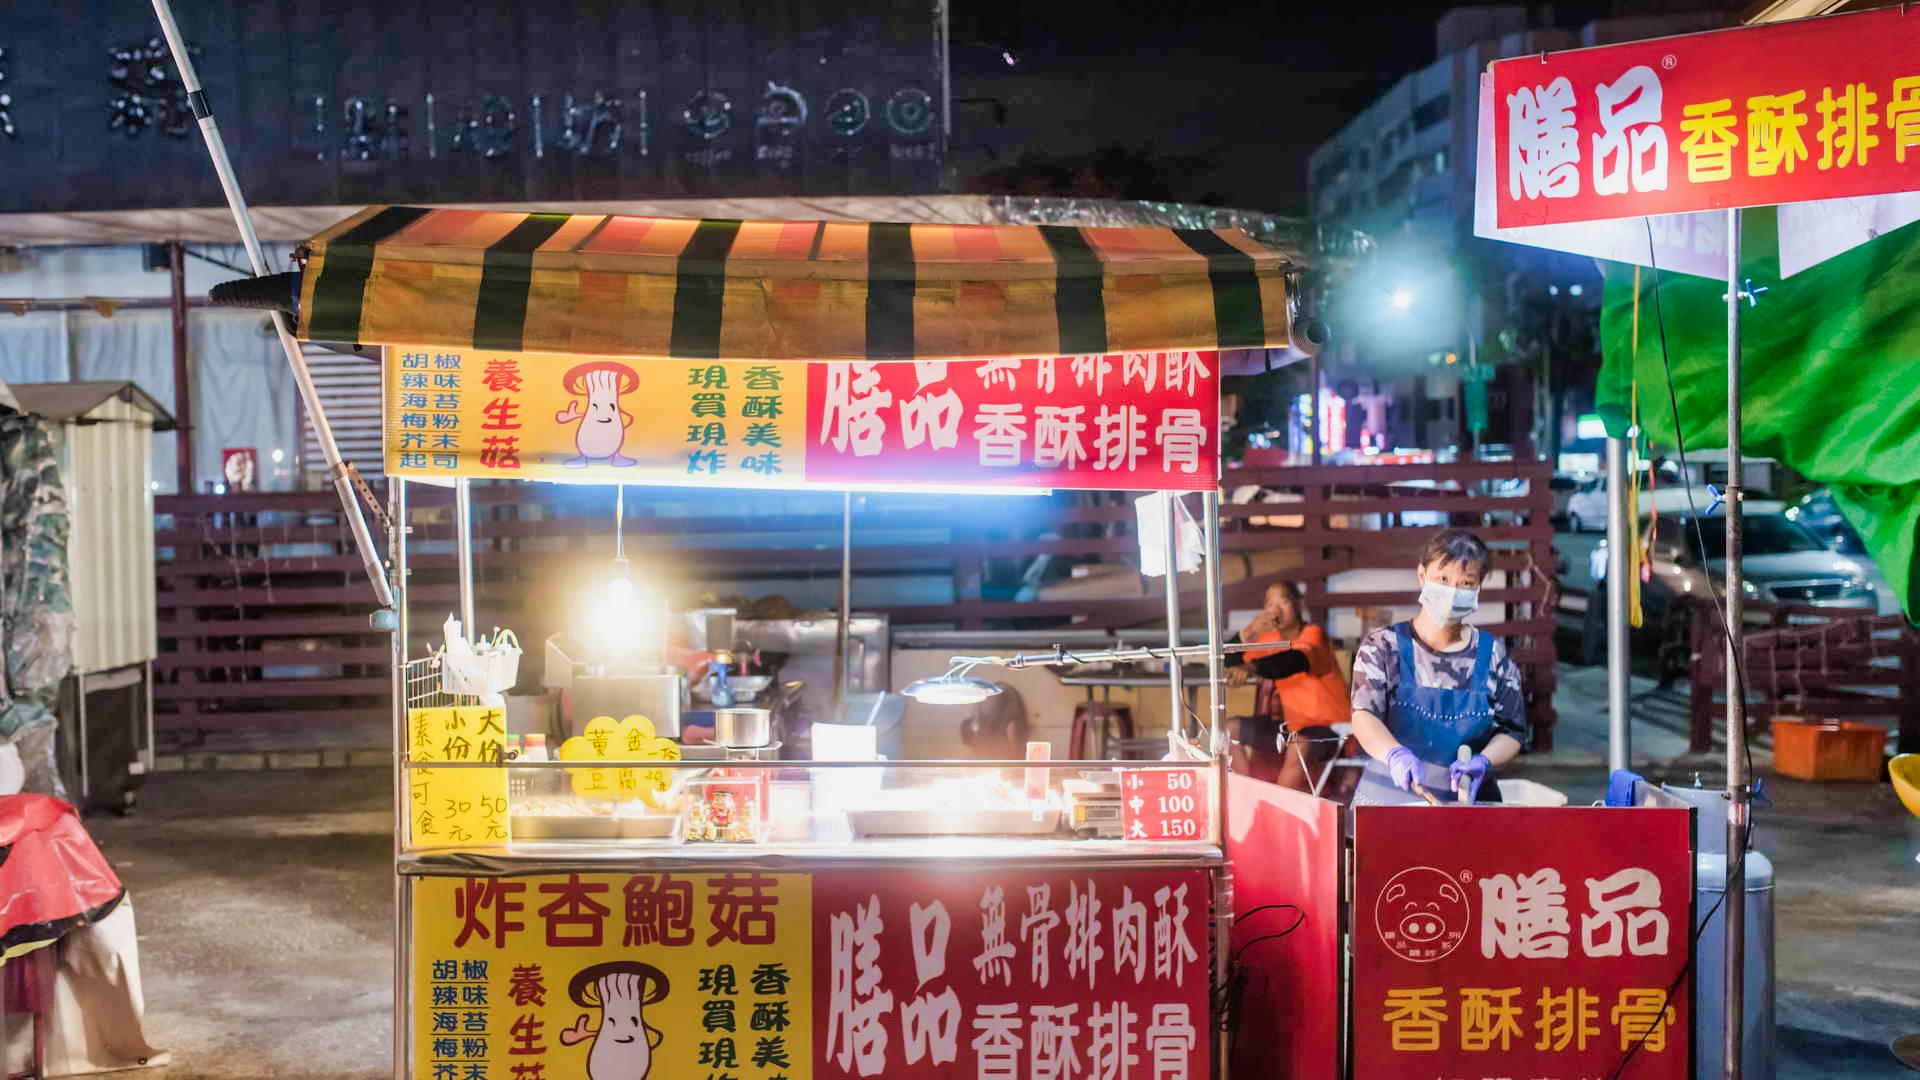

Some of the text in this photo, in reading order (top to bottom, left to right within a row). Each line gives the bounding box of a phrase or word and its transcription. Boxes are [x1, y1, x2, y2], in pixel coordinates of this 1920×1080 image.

[1507, 65, 1669, 201] 膳品
[400, 353, 462, 369] 胡椒
[400, 373, 461, 390] 辣味
[400, 393, 461, 410] 海苔
[400, 413, 460, 430] 梅粉
[479, 358, 522, 470] 養生菇
[686, 365, 730, 475] 現買現炸
[741, 365, 784, 475] 香酥美味
[400, 433, 460, 449] 芥末
[400, 452, 459, 469] 起司
[973, 403, 1208, 473] 香酥排骨
[443, 710, 471, 760] 小份
[1126, 773, 1192, 790] 小 50
[1128, 795, 1194, 815] 中 100
[1130, 819, 1197, 837] 大 150
[453, 873, 780, 949] 炸杏鮑菇
[972, 878, 1198, 991] 無骨排肉酥
[1479, 867, 1670, 959] 膳品
[432, 960, 489, 981] 胡椒
[432, 985, 488, 1005] 辣味
[826, 894, 962, 1077] 膳品
[432, 1012, 488, 1033] 海苔
[698, 964, 740, 1080] 現買現
[750, 963, 792, 1080] 香酥美
[971, 1001, 1196, 1080] 香酥排骨
[1383, 986, 1676, 1052] 香酥排骨
[432, 1038, 488, 1058] 梅粉
